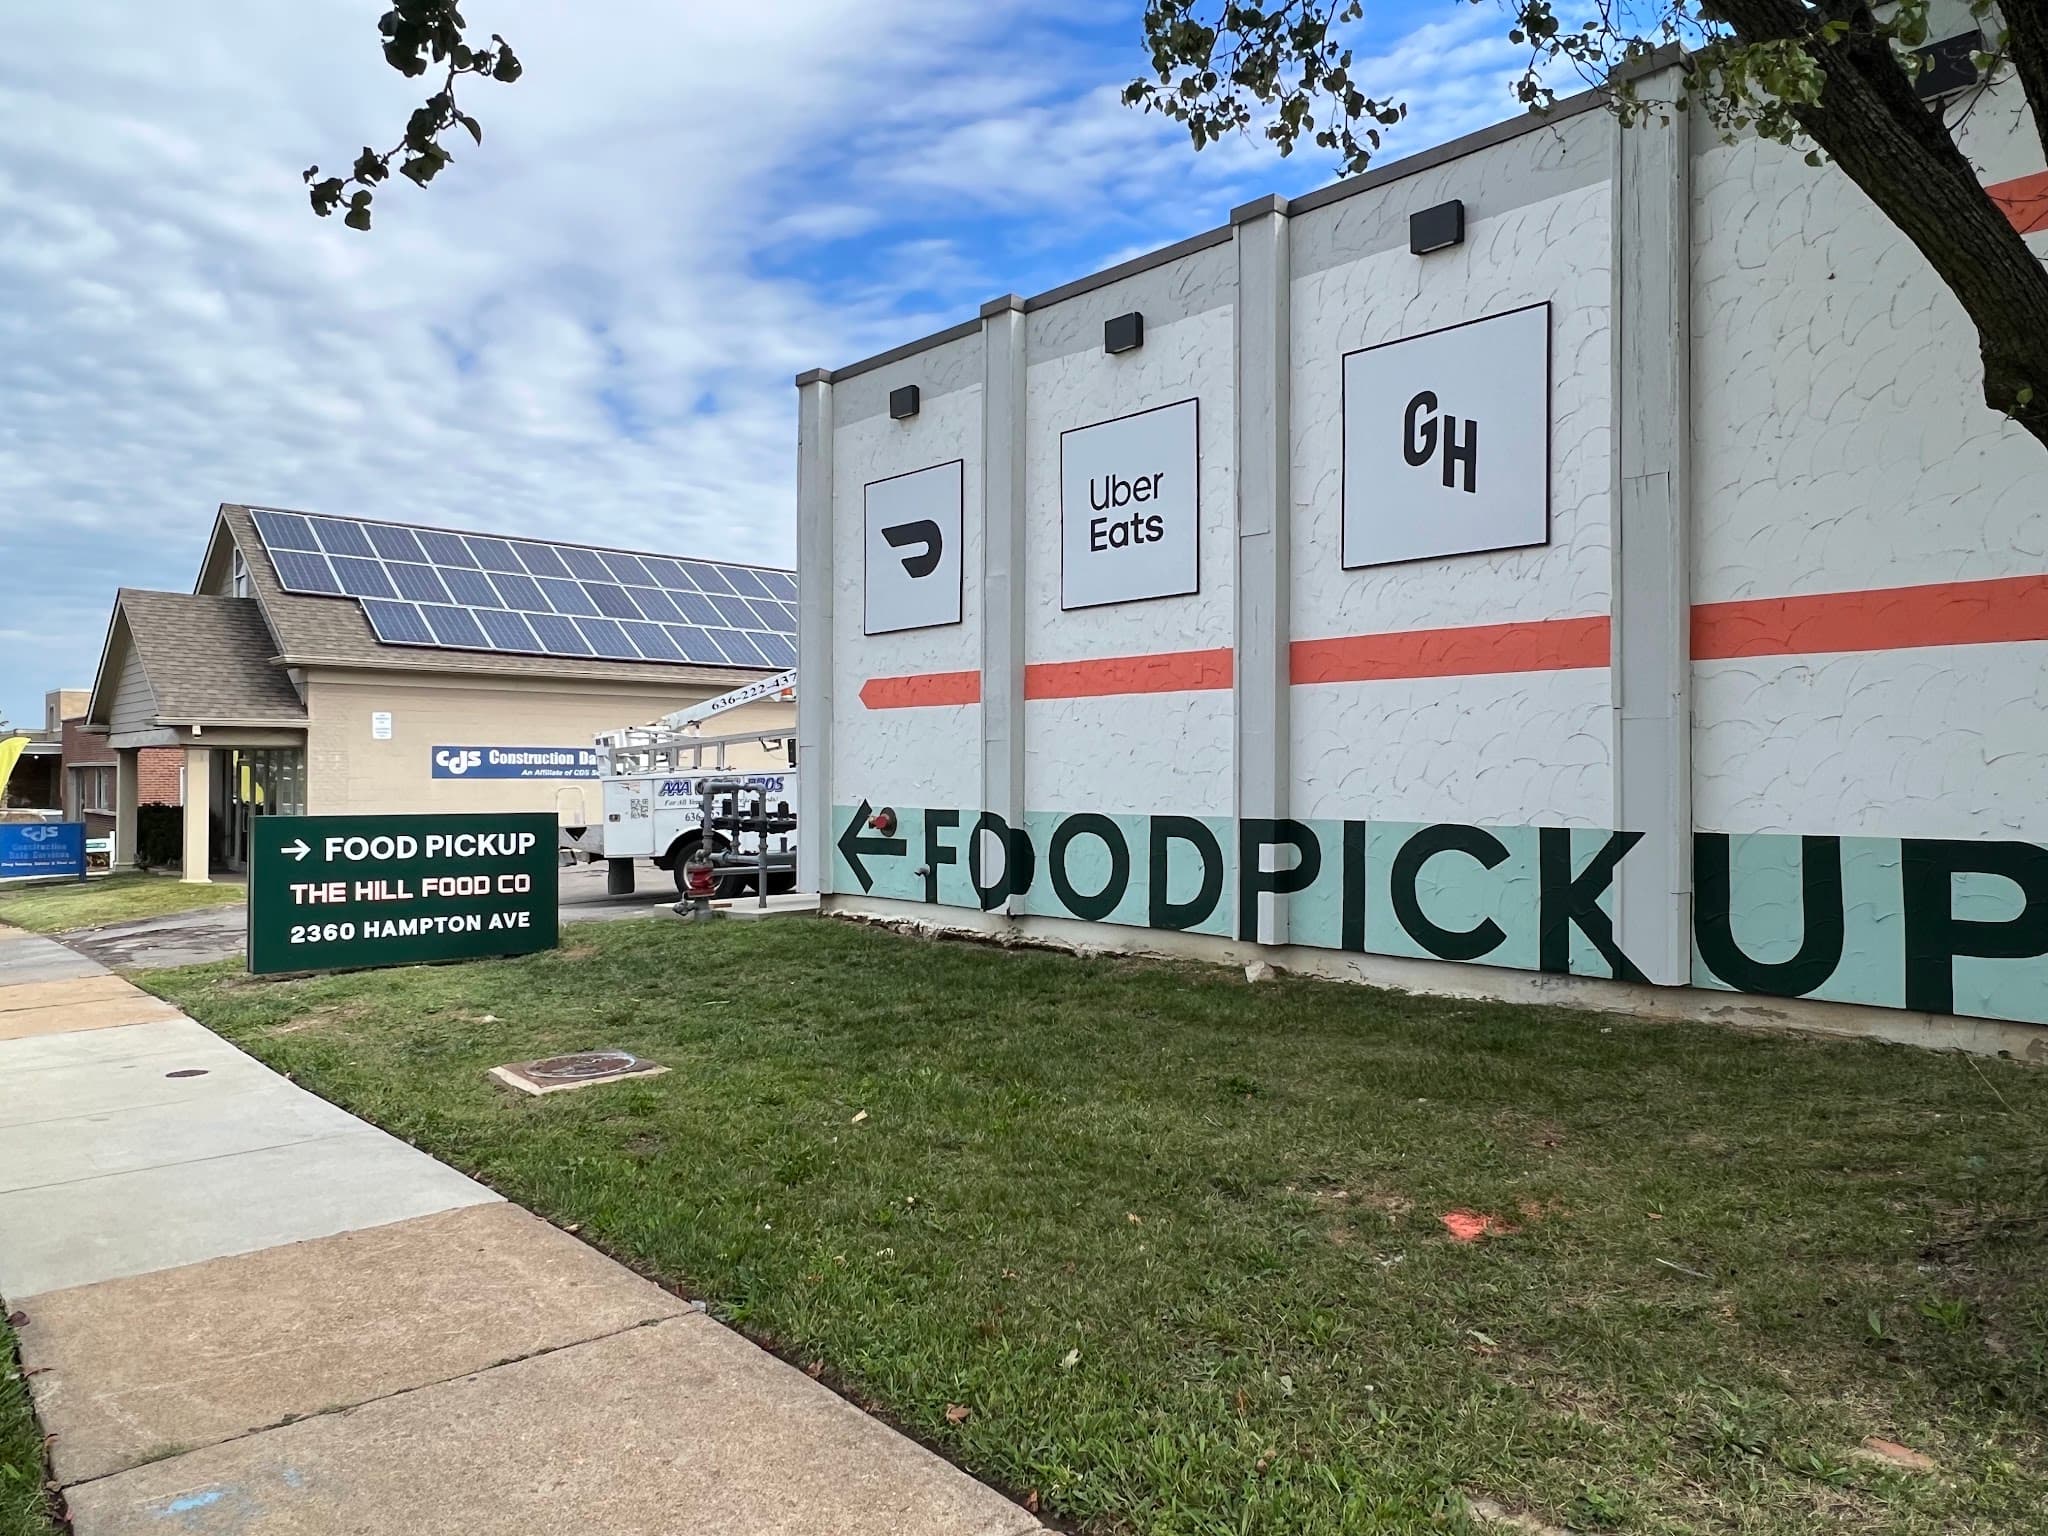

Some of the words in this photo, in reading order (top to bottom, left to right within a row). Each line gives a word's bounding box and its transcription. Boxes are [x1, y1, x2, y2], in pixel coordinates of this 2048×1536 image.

[1403, 390, 1478, 493] GH
[1089, 469, 1164, 512] Uber
[1090, 510, 1164, 552] Eats
[711, 672, 797, 710] 636-222-437
[489, 749, 574, 765] Construction
[578, 751, 597, 766] Da
[658, 780, 692, 796] AAA
[325, 835, 418, 862] FOOD
[425, 832, 536, 858] PICKUP
[289, 882, 347, 905] THE
[354, 879, 413, 902] HILL
[422, 875, 490, 898] FOOD
[497, 873, 531, 894] CO
[290, 922, 355, 944] 2360
[363, 914, 482, 939] HAMPTON
[488, 911, 531, 930] AVE
